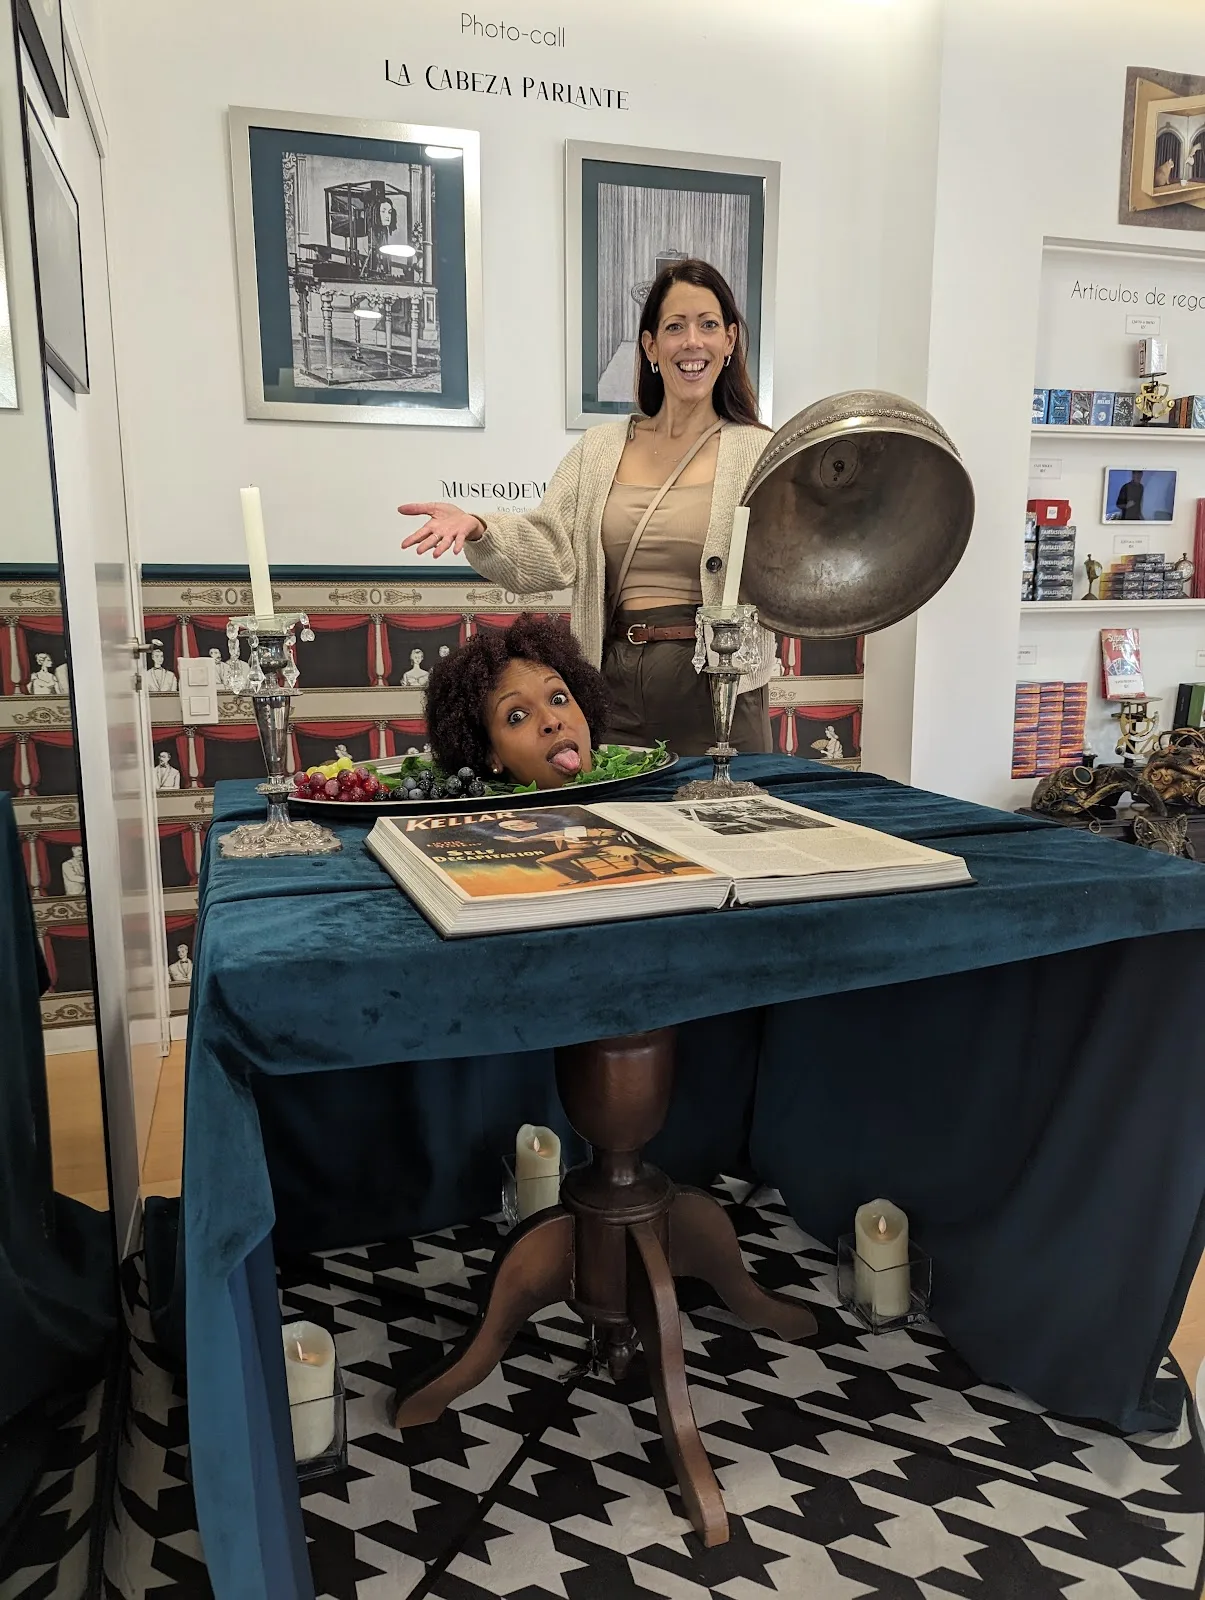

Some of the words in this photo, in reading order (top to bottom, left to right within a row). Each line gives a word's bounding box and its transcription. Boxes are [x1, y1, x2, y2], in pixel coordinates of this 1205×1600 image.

[460, 12, 566, 48] Photo-call
[384, 59, 416, 87] LA
[425, 64, 513, 97] CABEZA
[521, 75, 630, 110] PARLANTE
[1145, 286, 1166, 307] de
[405, 812, 517, 832] KELLAR
[431, 849, 546, 863] DECAPITATION
[446, 848, 496, 857] SELF
